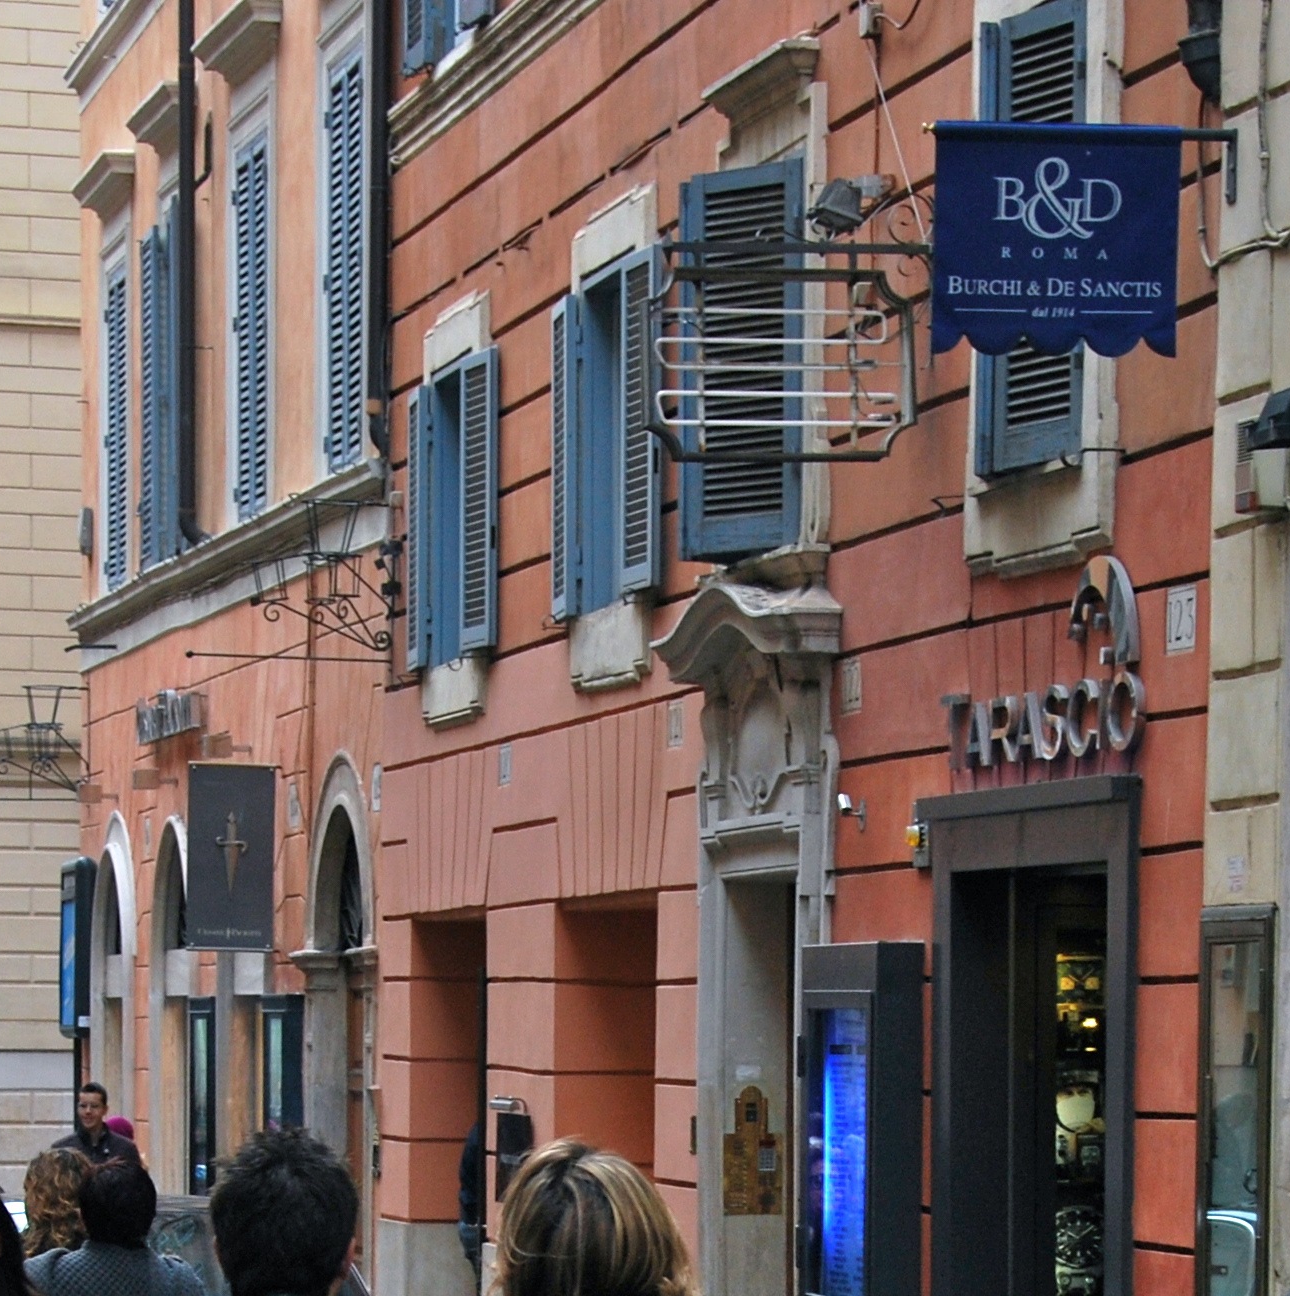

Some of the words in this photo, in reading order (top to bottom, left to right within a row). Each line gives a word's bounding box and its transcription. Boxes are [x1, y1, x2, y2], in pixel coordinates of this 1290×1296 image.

[1001, 246, 1108, 260] ROMA
[947, 275, 1022, 296] BURCHI
[1026, 281, 1040, 297] &
[1046, 277, 1075, 297] DE
[1080, 278, 1162, 299] SANCTIS
[1051, 306, 1075, 318] 1914
[1167, 596, 1195, 643] 123
